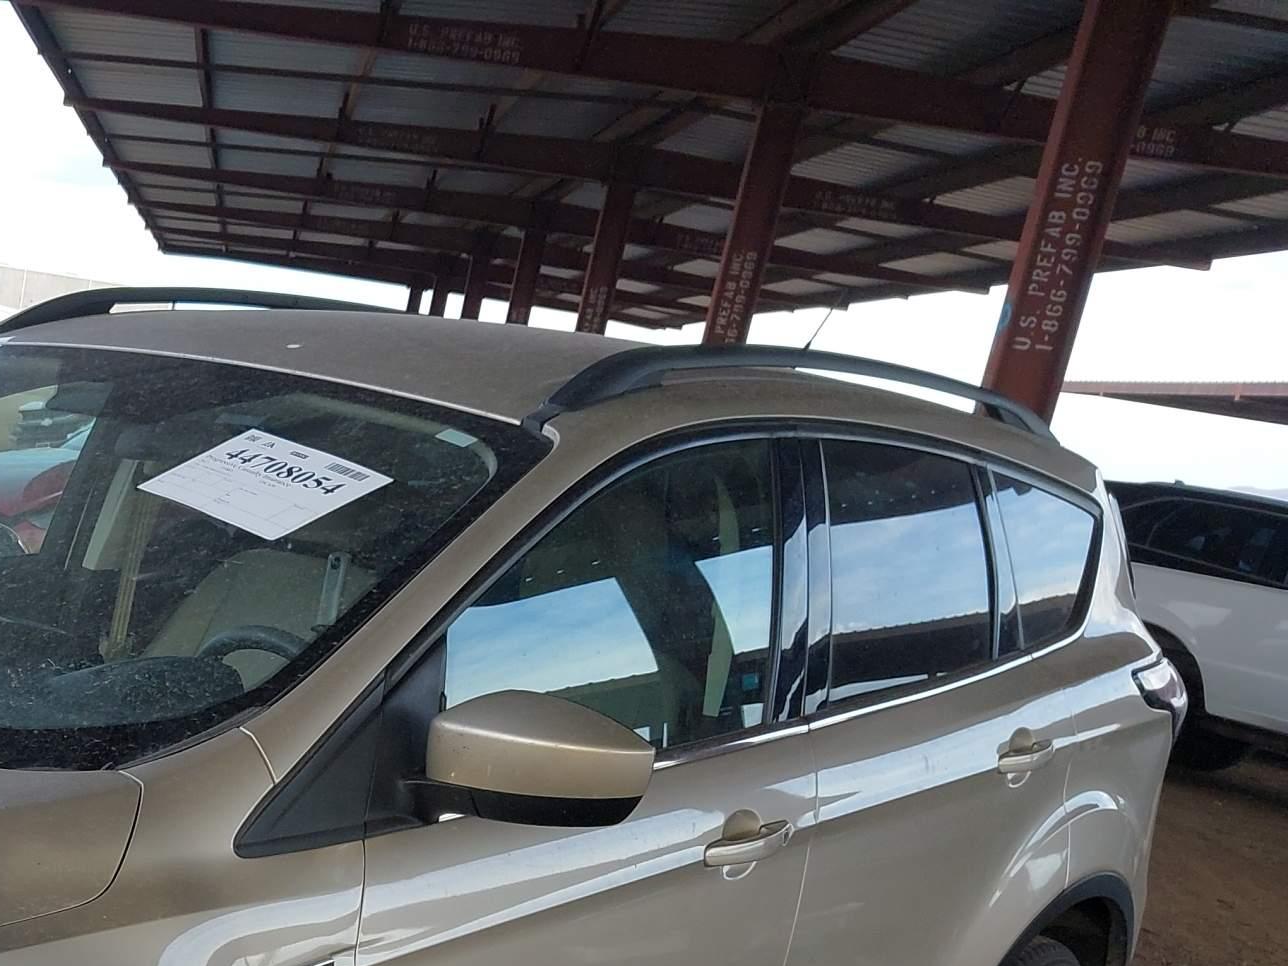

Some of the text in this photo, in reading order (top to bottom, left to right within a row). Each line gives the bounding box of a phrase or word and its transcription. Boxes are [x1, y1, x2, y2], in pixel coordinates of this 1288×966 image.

[715, 280, 738, 334] PREFAB
[1012, 156, 1083, 351] U.S. PREFAB INC.
[1034, 160, 1104, 351] 1-866-799-0969
[225, 448, 347, 495] 44708054
